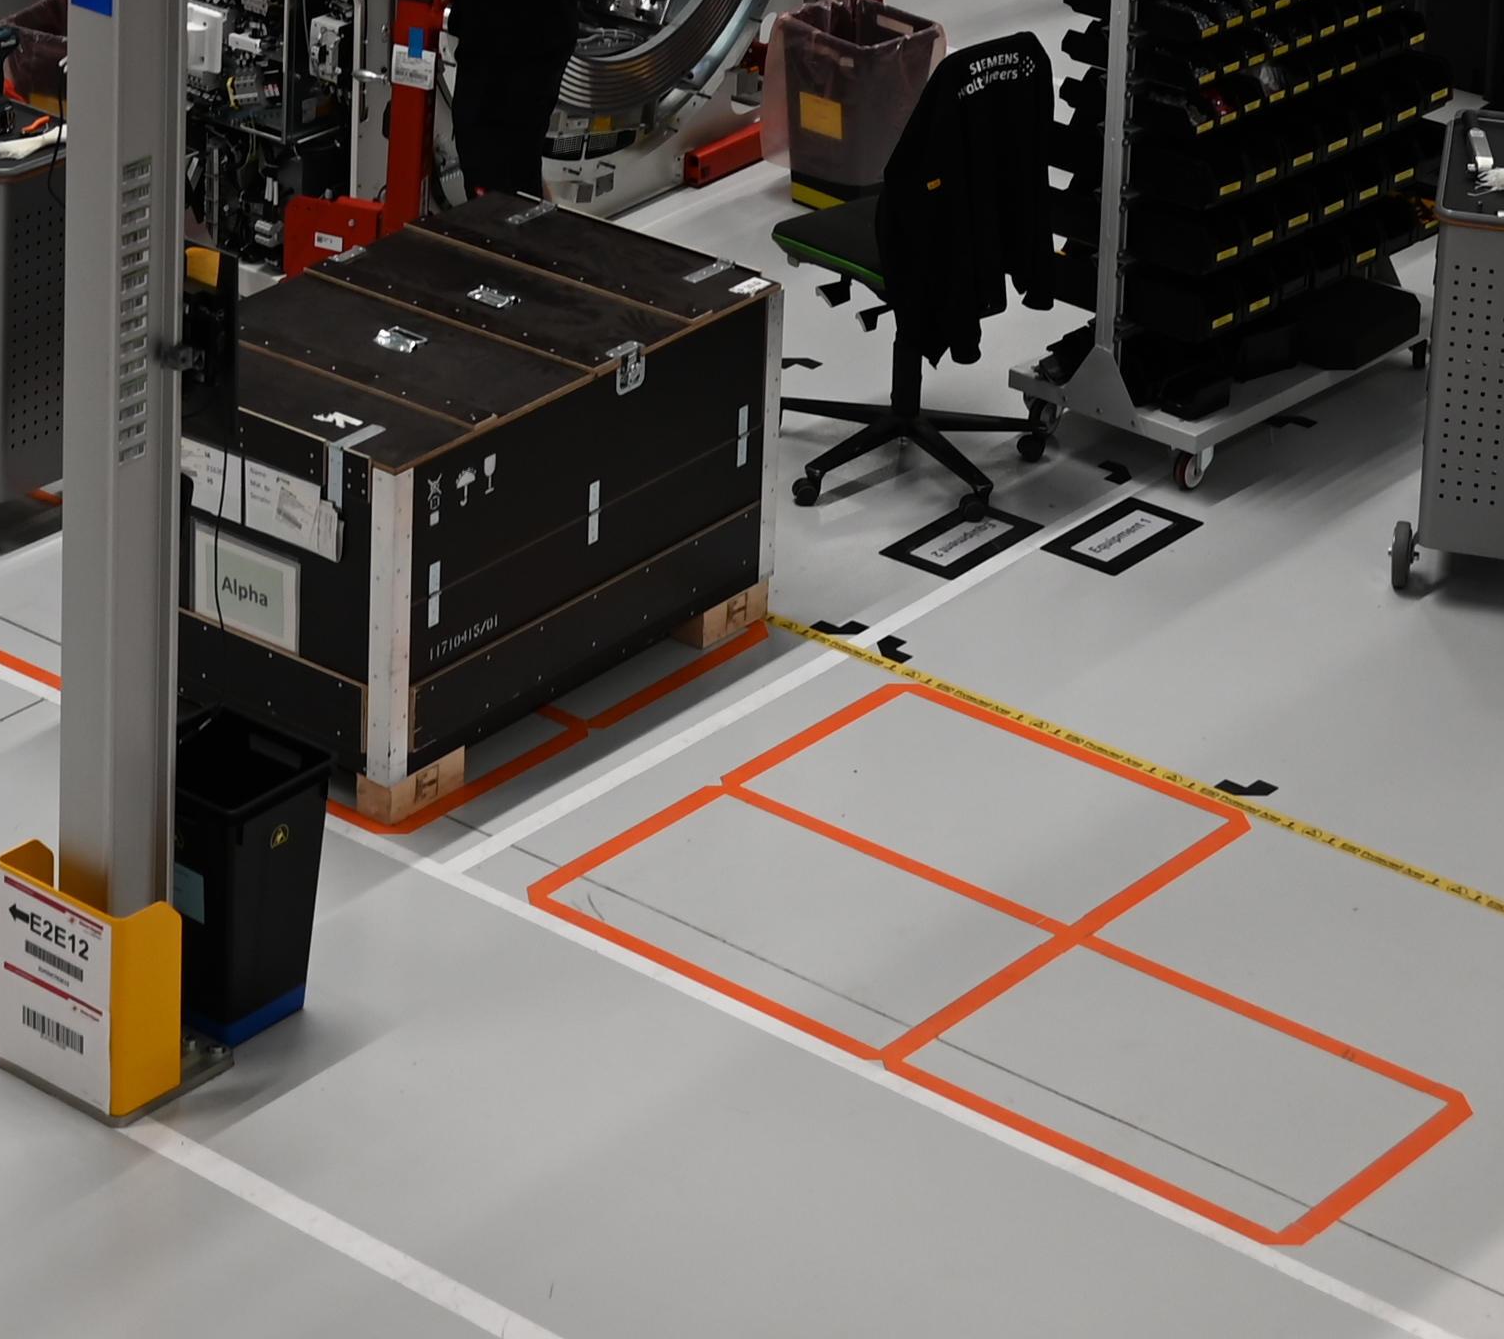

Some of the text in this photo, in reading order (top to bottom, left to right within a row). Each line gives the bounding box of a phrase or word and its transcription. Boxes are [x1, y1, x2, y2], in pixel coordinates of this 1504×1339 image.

[969, 52, 1019, 75] SIEMENS
[221, 575, 269, 608] Alpha
[830, 640, 866, 660] Protected
[955, 689, 993, 709] Protected
[1084, 740, 1122, 761] Protected
[1220, 794, 1261, 815] Protected
[1361, 850, 1403, 872] Protected
[29, 912, 90, 962] E2E12
